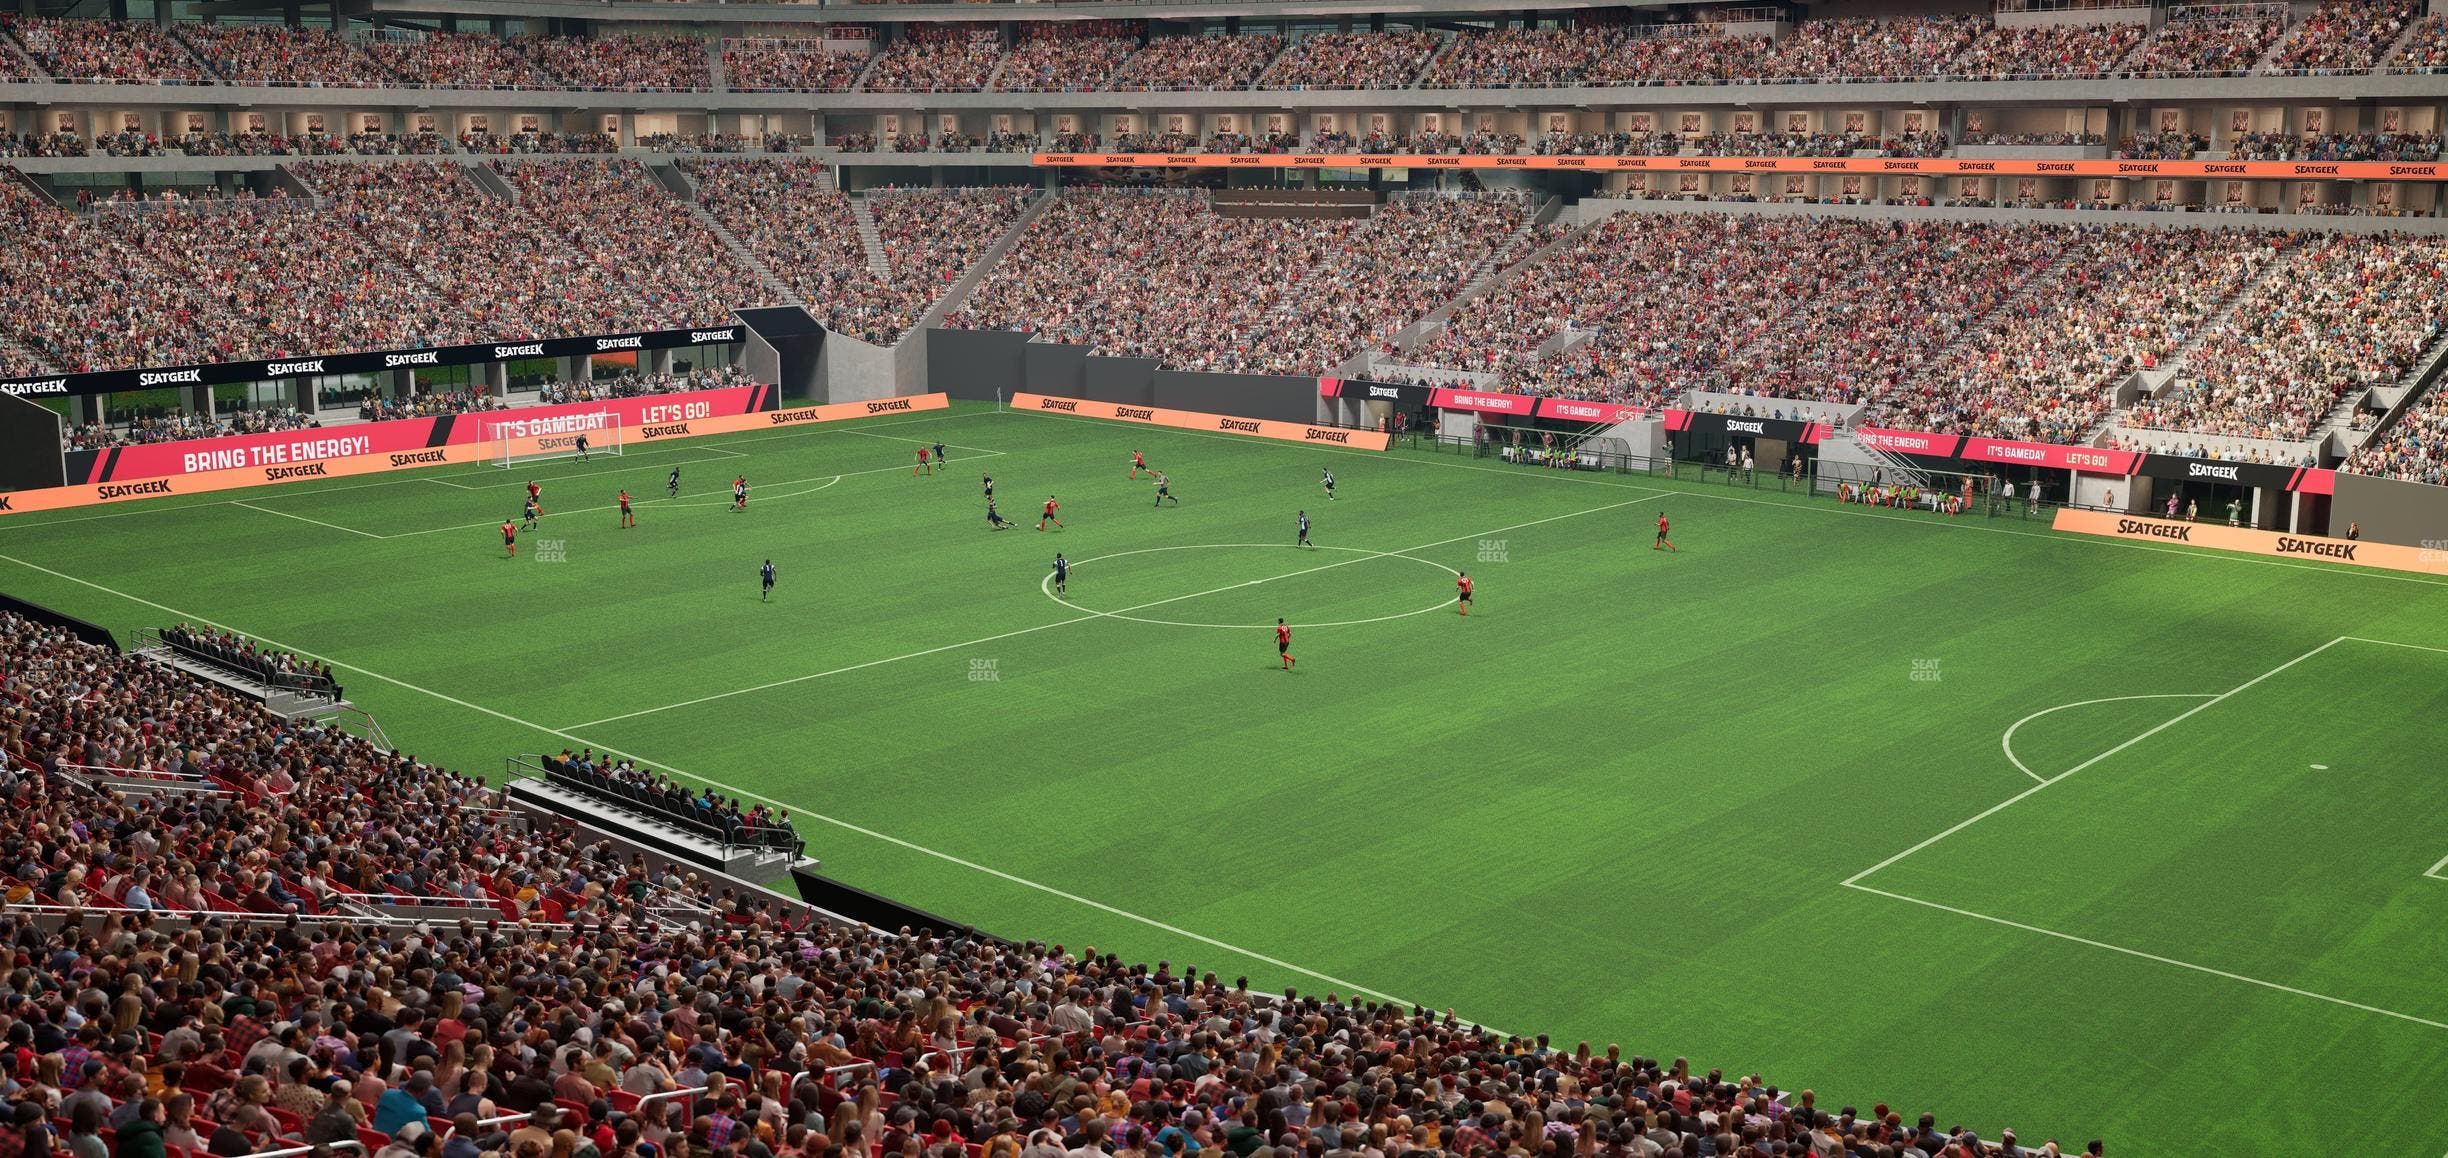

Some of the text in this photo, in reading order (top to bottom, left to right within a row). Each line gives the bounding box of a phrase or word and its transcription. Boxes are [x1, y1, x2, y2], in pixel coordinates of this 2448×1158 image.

[1427, 158, 1460, 166] SEATGEEK
[1496, 158, 1527, 166] SEATGEEK
[1679, 160, 1711, 168] SEATGEEK
[1744, 161, 1777, 169] SEATGEEK
[1813, 161, 1847, 169] SEATGEEK
[1884, 162, 1920, 170] SEATGEEK
[1958, 162, 1996, 171] SEATGEEK
[2036, 163, 2075, 172] SEATGEEK
[2118, 164, 2159, 173] SEATGEEK
[2204, 165, 2247, 174] SEATGEEK
[2294, 166, 2340, 175] SEATGEEK
[2389, 166, 2437, 176] SEATGEEK
[0, 329, 734, 394] SEATGEEK SEATGEEK SEATGEEK SEATGEEK SEATGEEK SEATGEEK SEATGEEK
[1370, 386, 1399, 399] SEATGEEK
[1454, 395, 1512, 409] BRING THE ENERGY!
[1556, 404, 1601, 418] IT'S GAMEDAY
[642, 401, 710, 424] LET'S GO!
[1041, 398, 1349, 444] SEATGEEK SEATGEEK SEATGEEK SEATGEEK
[496, 411, 605, 440] IT'S GAMEDAY
[1726, 420, 1764, 435] SEATGEEK
[98, 479, 172, 500] SEATGEEK
[265, 462, 327, 481] SEATGEEK
[390, 448, 447, 466] SEATGEEK
[642, 422, 690, 439] SEATGEEK
[770, 409, 818, 424] SEATGEEK
[867, 398, 912, 414] SEATGEEK
[1878, 435, 1892, 446] THE
[1894, 436, 1928, 449] ENERGY!
[184, 436, 370, 473] BRING THE ENERGY!
[1987, 446, 2046, 460] IT'S GAMEDAY
[2066, 452, 2108, 466] LET'S GO!
[2189, 462, 2238, 481] SEATGEEK
[2117, 518, 2358, 560] SEATGEEK SEATGEEK
